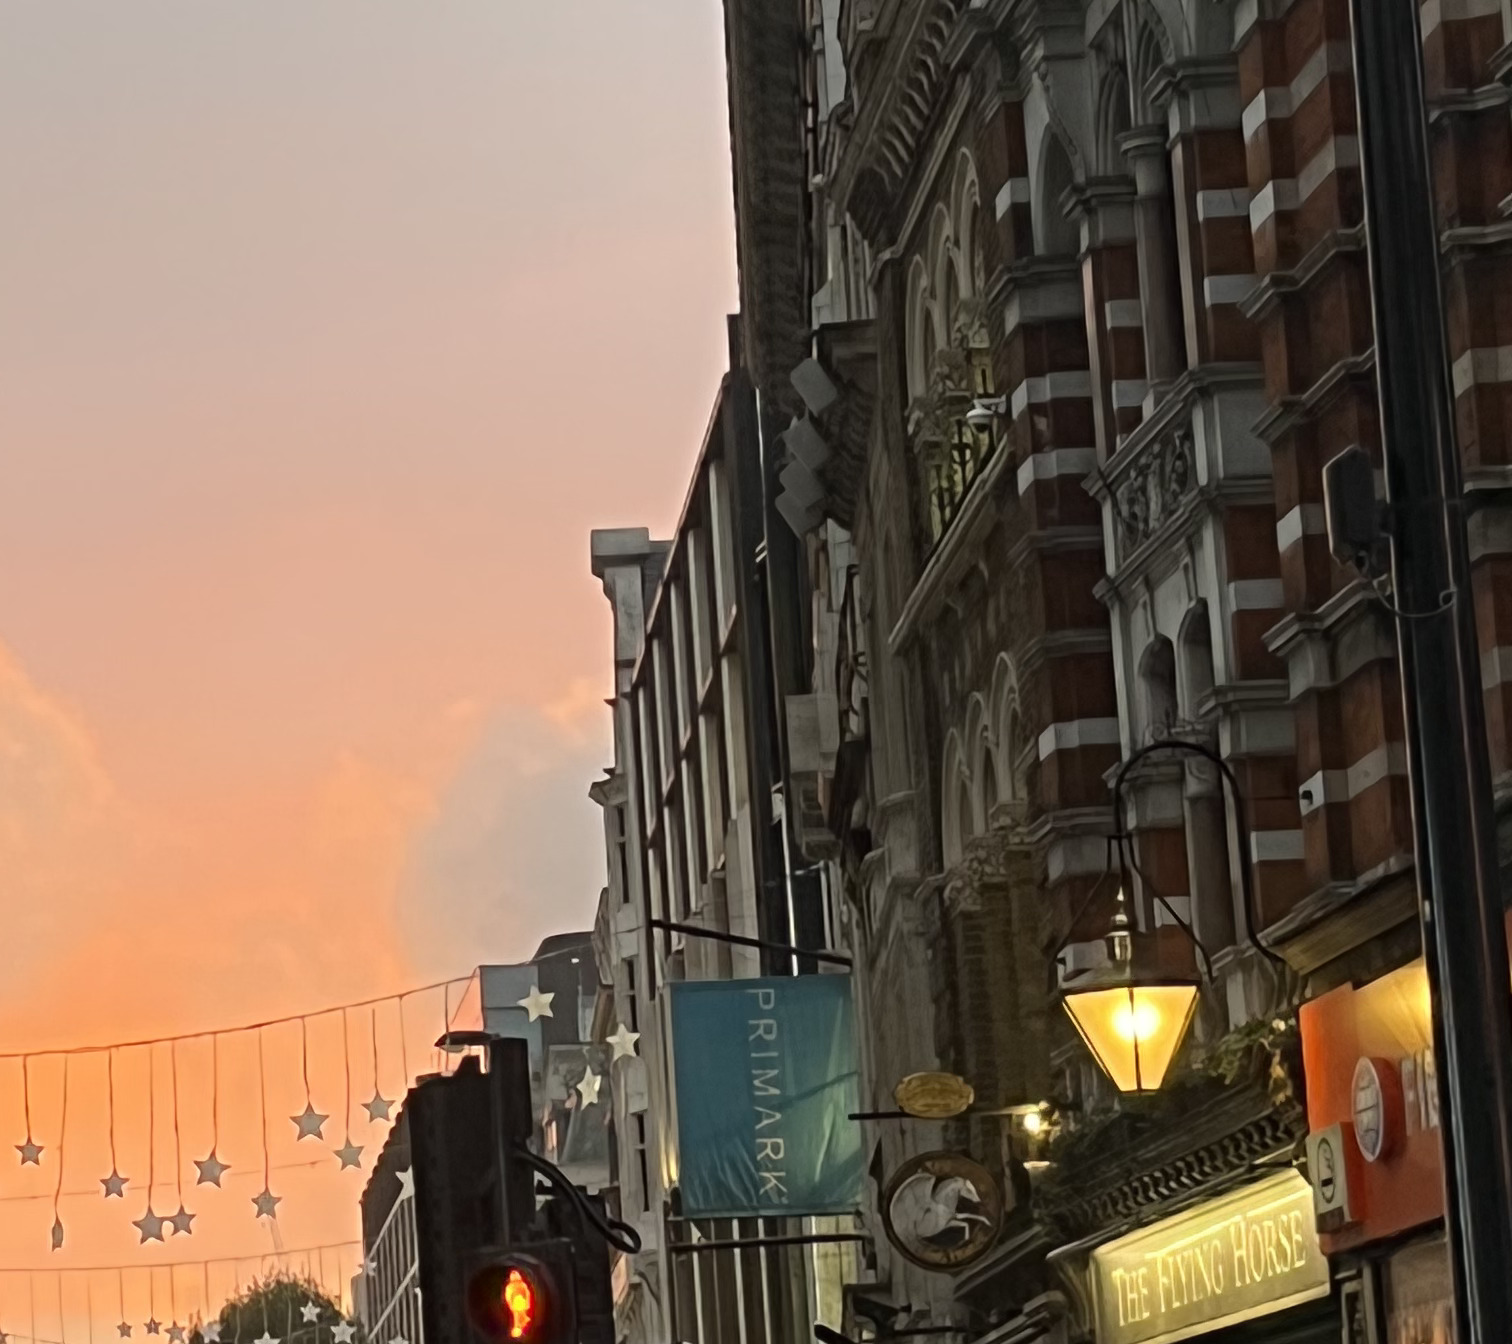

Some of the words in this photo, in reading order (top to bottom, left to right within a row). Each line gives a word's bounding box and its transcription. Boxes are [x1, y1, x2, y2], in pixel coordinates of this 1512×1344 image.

[745, 987, 789, 1197] PRIMARK
[1111, 1266, 1150, 1327] THE
[1156, 1239, 1225, 1313] FLYING
[1229, 1210, 1307, 1288] HORSE
